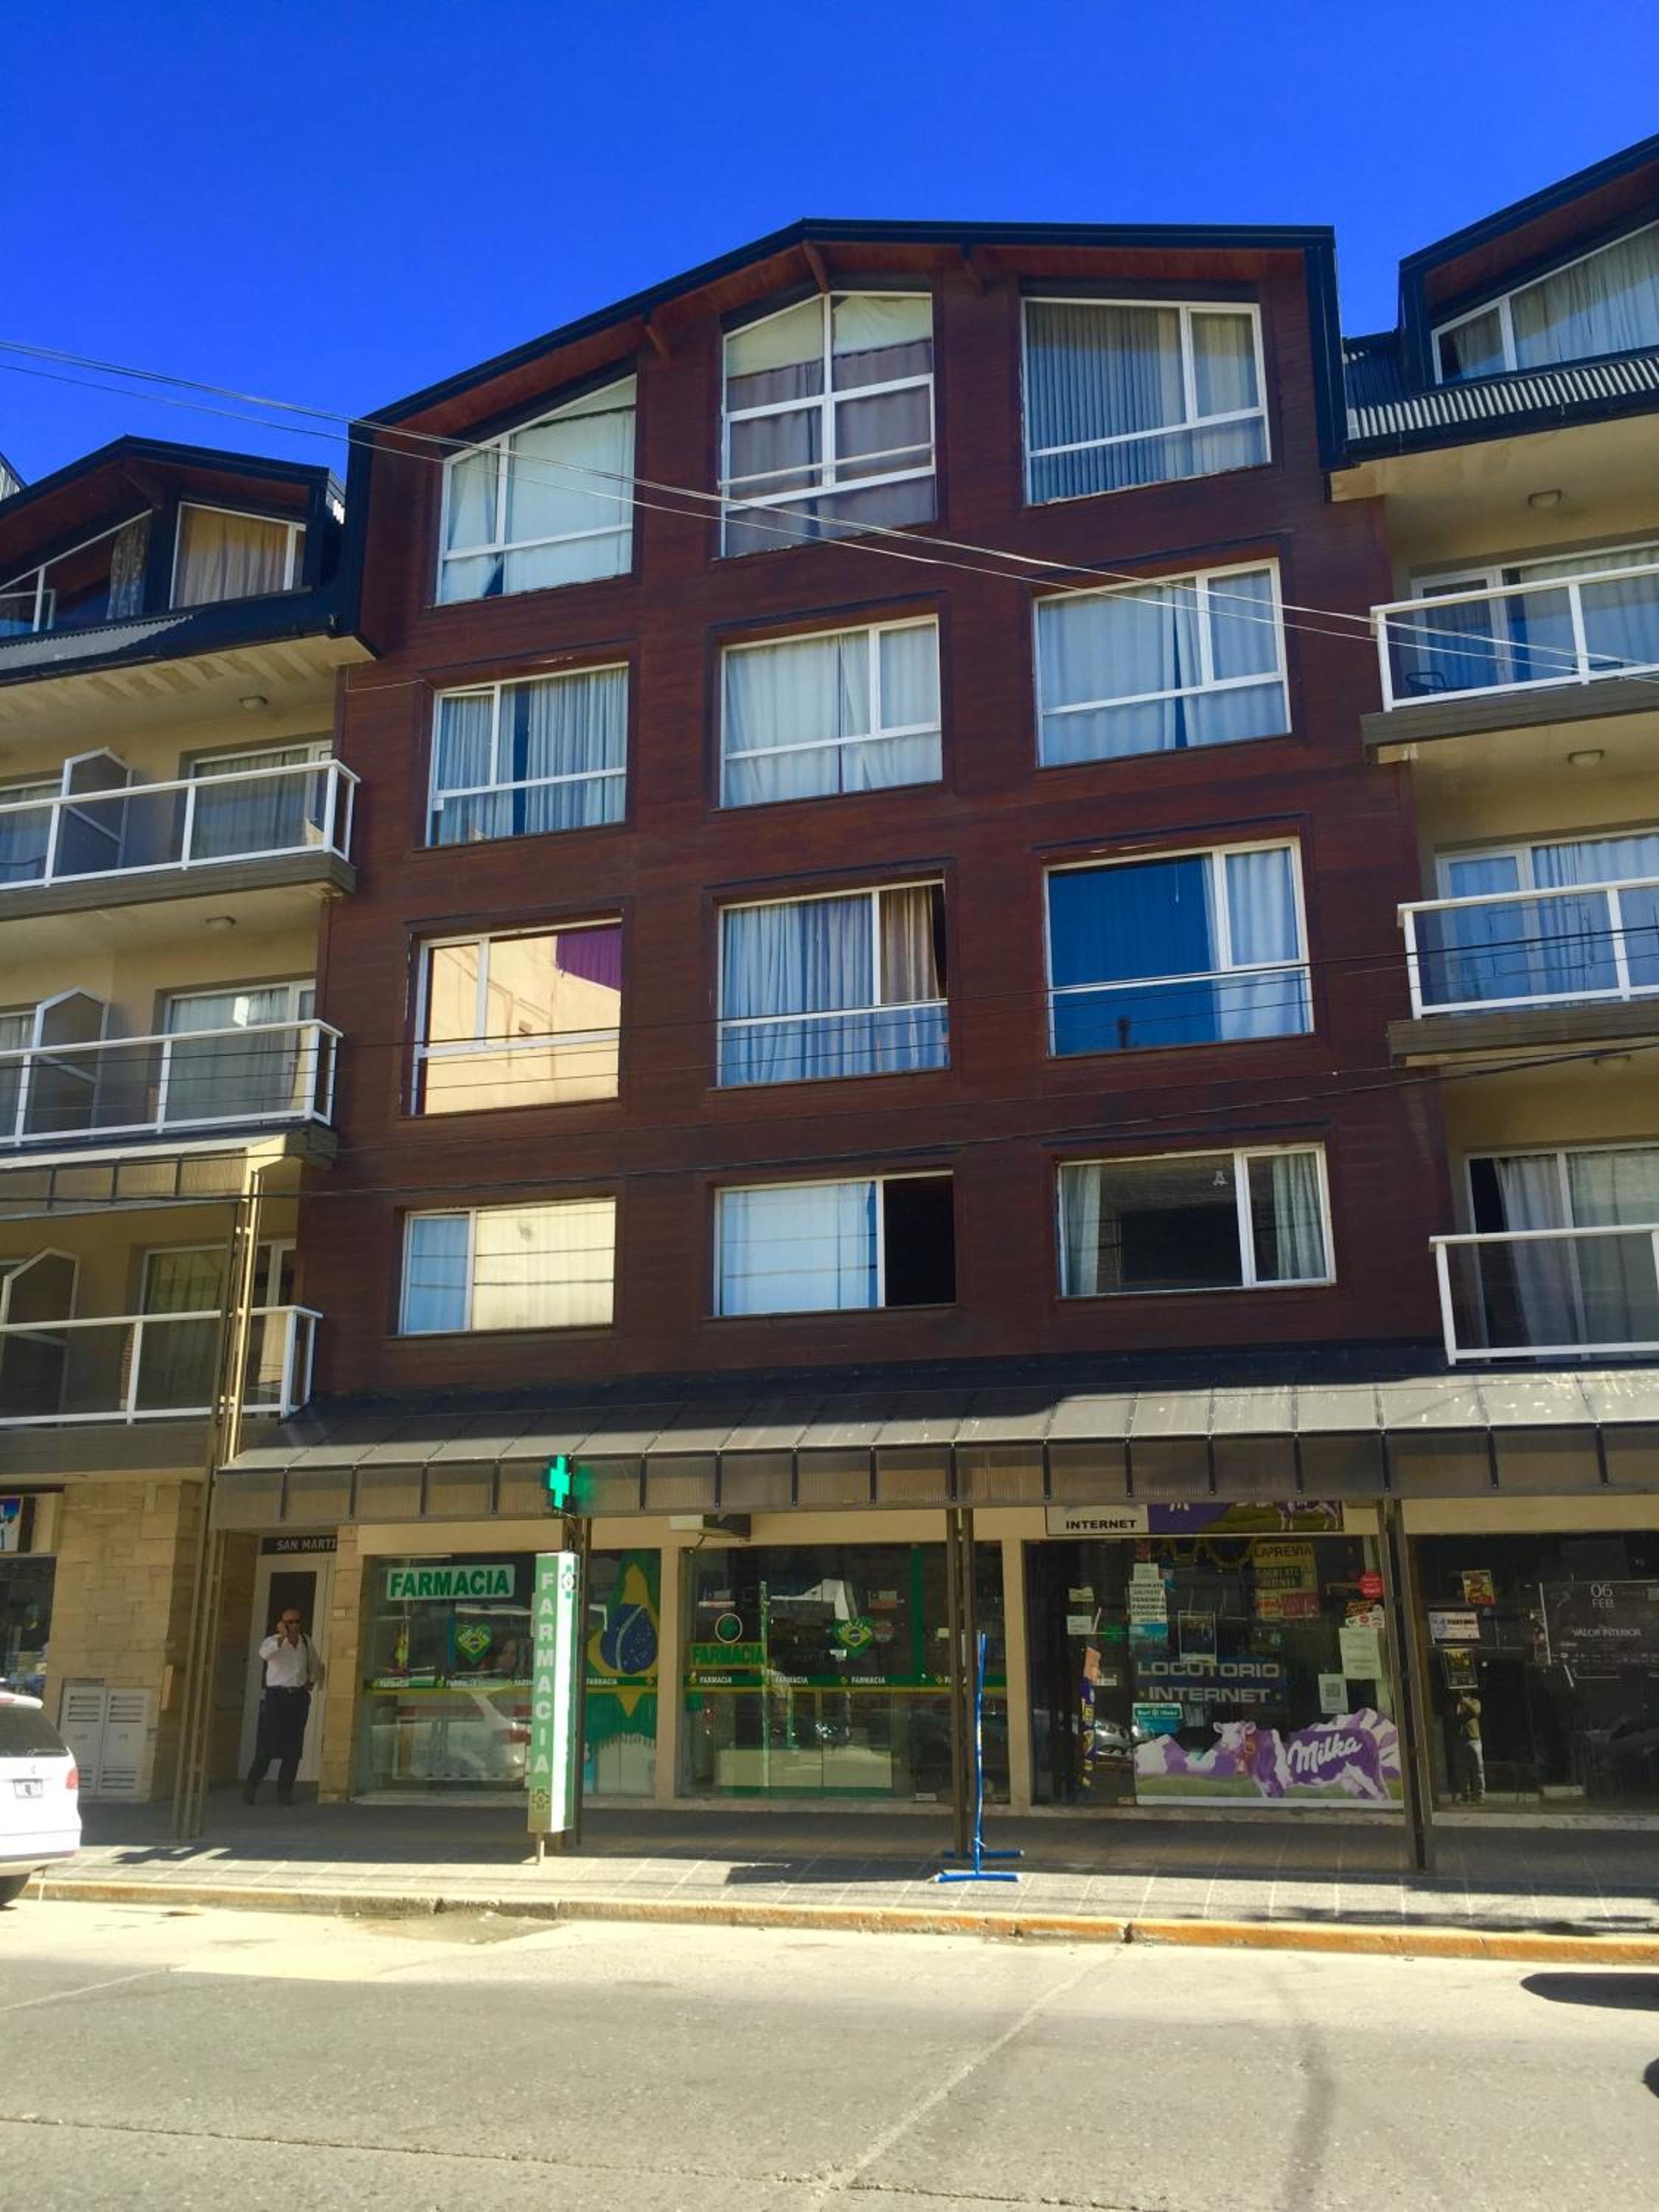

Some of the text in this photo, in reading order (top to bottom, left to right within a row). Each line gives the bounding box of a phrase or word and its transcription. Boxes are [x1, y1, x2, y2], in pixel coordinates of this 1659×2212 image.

[1066, 1520, 1136, 1530] INTERNET
[277, 1539, 335, 1550] SAN MARTI
[390, 1570, 509, 1596] FARMACIA
[1591, 1584, 1613, 1598] 06
[692, 1646, 764, 1664] FARMACIA
[535, 1572, 554, 1773] FARMACIA
[586, 1677, 618, 1685] FARMACIA
[700, 1675, 732, 1684] FARMACIA
[775, 1675, 808, 1684] FARMACIA
[852, 1675, 885, 1684] FARMACIA
[1149, 1686, 1270, 1703] INTERNET
[1287, 1733, 1363, 1773] Milka
